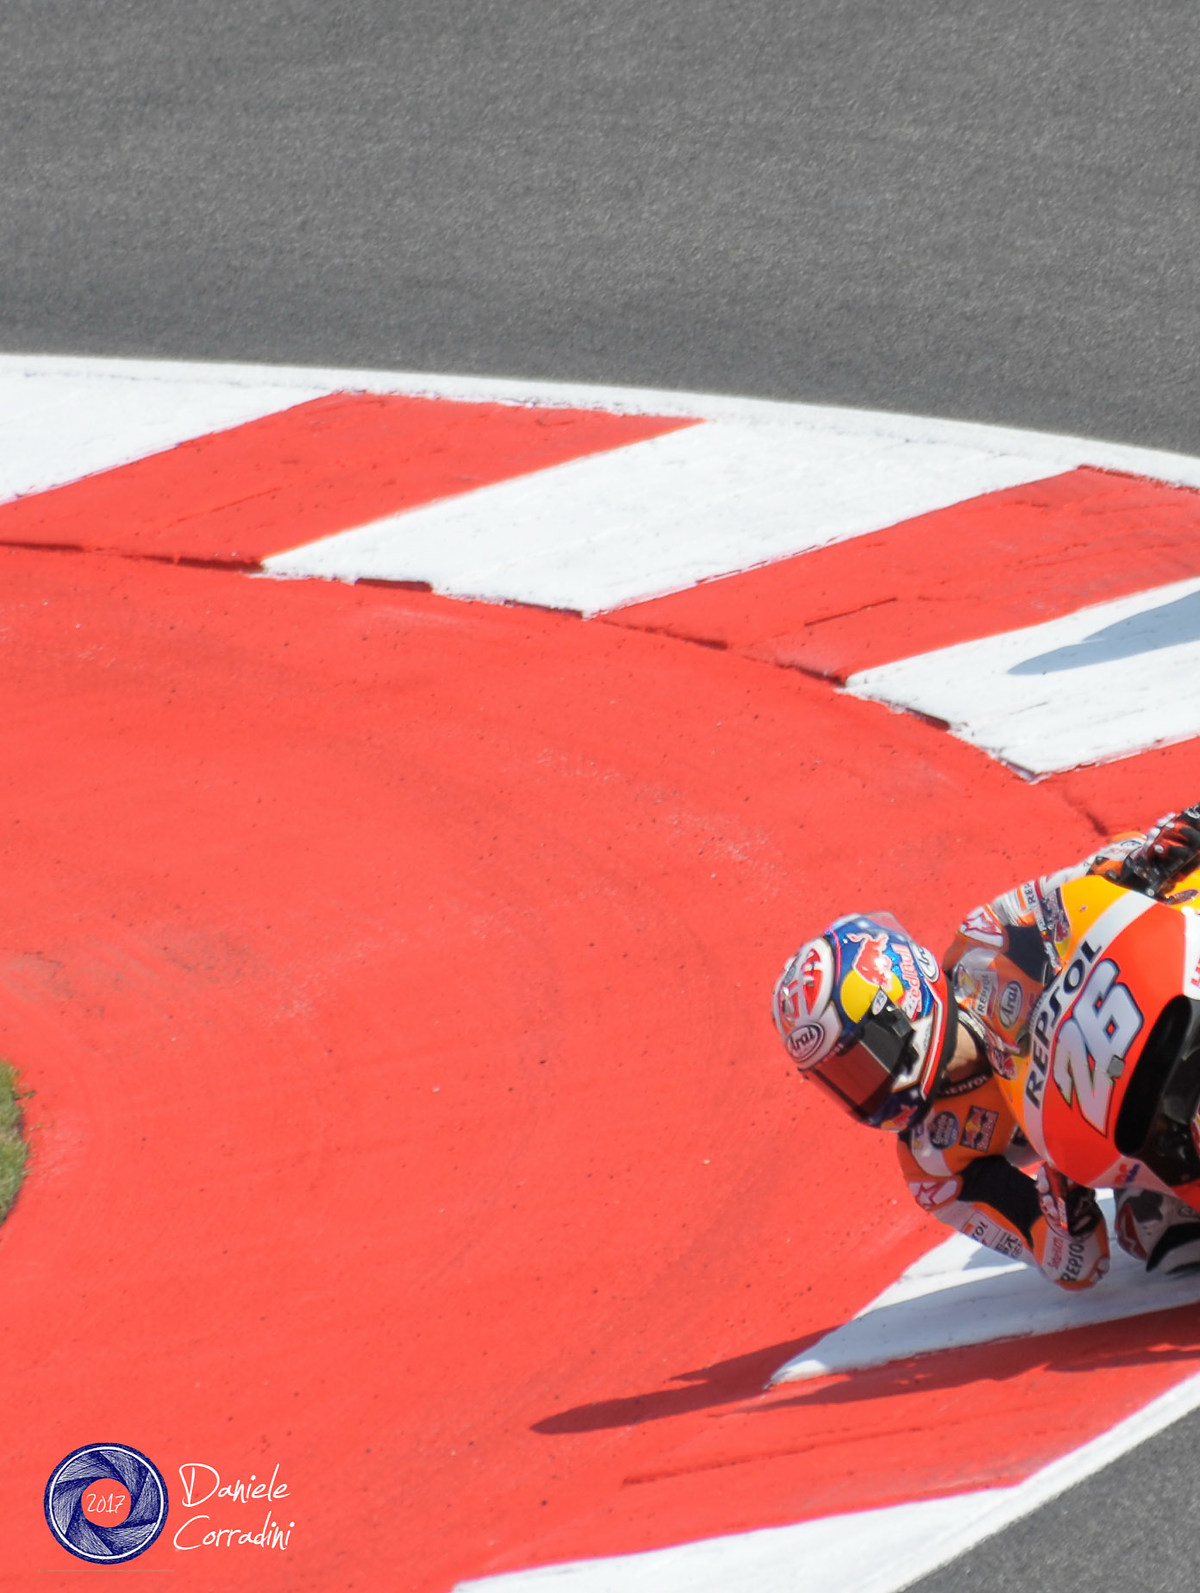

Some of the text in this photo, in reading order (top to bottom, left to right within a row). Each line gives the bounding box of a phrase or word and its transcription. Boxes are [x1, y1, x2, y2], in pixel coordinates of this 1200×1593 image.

[976, 974, 990, 1015] REPSOL
[1000, 983, 1021, 1024] Arai
[1025, 941, 1102, 1109] REPSOL
[1053, 958, 1144, 1138] 26
